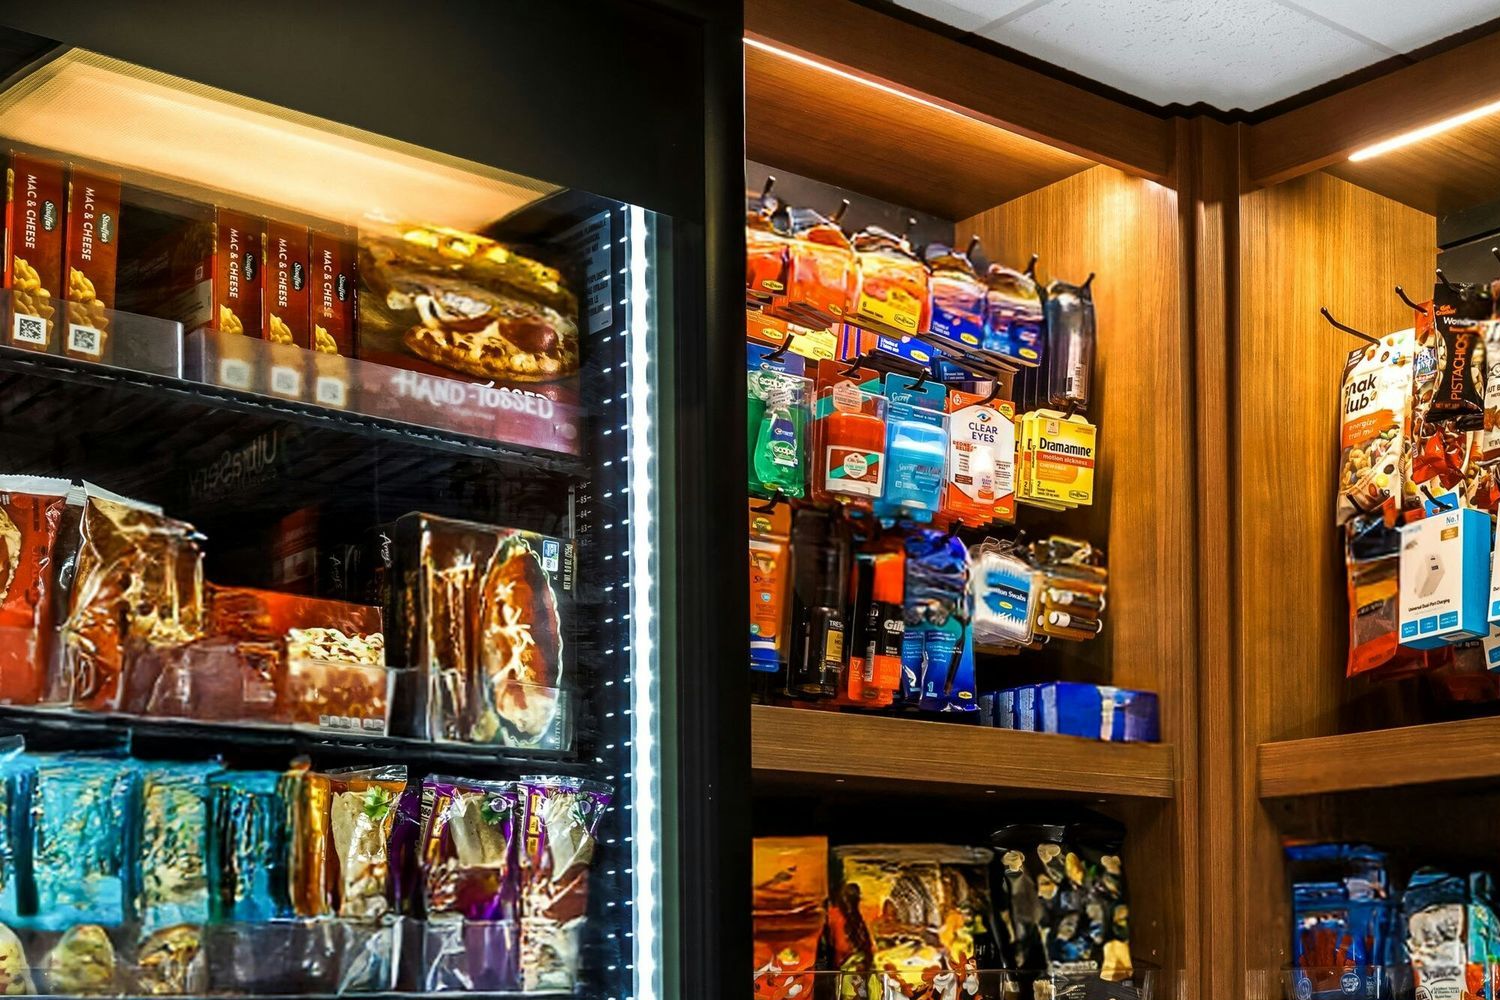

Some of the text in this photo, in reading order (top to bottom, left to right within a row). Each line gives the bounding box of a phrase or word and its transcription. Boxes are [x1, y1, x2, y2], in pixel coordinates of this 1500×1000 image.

[27, 174, 37, 199] MAC
[25, 209, 37, 249] CHEESE
[81, 187, 96, 261] MAC & CHEESE
[230, 228, 239, 251] MAC
[229, 261, 239, 299] CHEESE
[278, 238, 288, 308] MAC & CHEESE
[323, 250, 333, 319] MAC & CHEESE
[1451, 333, 1469, 401] PISTACHIOS
[891, 392, 913, 403] Secret
[1345, 393, 1370, 415] lub
[968, 422, 998, 435] CLEAR
[972, 432, 995, 443] EYES
[1039, 437, 1091, 457] Dramamine
[1042, 454, 1088, 466] motion sickness
[1446, 514, 1459, 525] No.1
[1008, 591, 1027, 602] Swabs
